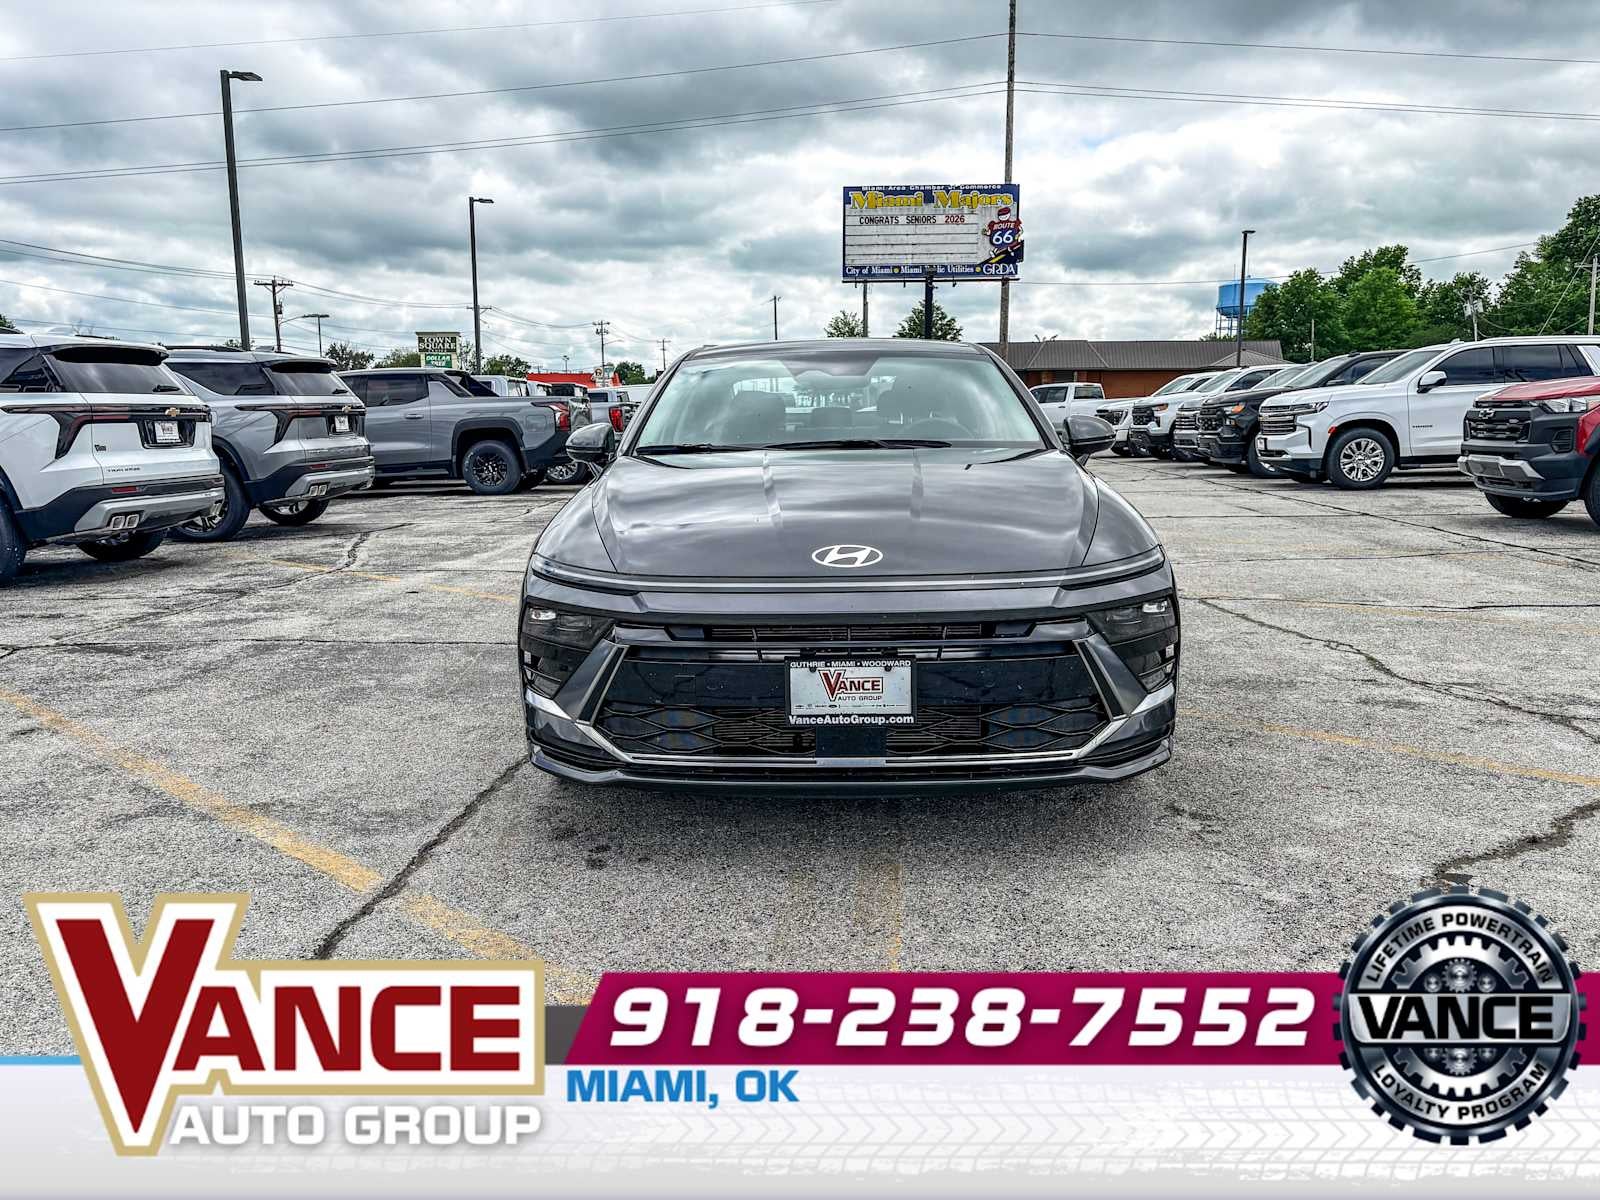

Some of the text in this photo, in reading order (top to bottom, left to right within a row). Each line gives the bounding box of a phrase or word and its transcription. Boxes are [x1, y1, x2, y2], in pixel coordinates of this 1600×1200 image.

[849, 190, 1013, 209] Miami Majors
[859, 215, 966, 225] CONGRATS SENIORS 2026
[992, 222, 1015, 230] ROUTE
[992, 230, 1014, 245] 66
[845, 266, 893, 276] City of Miami
[900, 265, 922, 274] Miami
[947, 264, 975, 273] Utilities
[982, 263, 1016, 275] GRDA
[820, 671, 882, 700] VANCE
[788, 714, 915, 725] VanceAutoGroup.com
